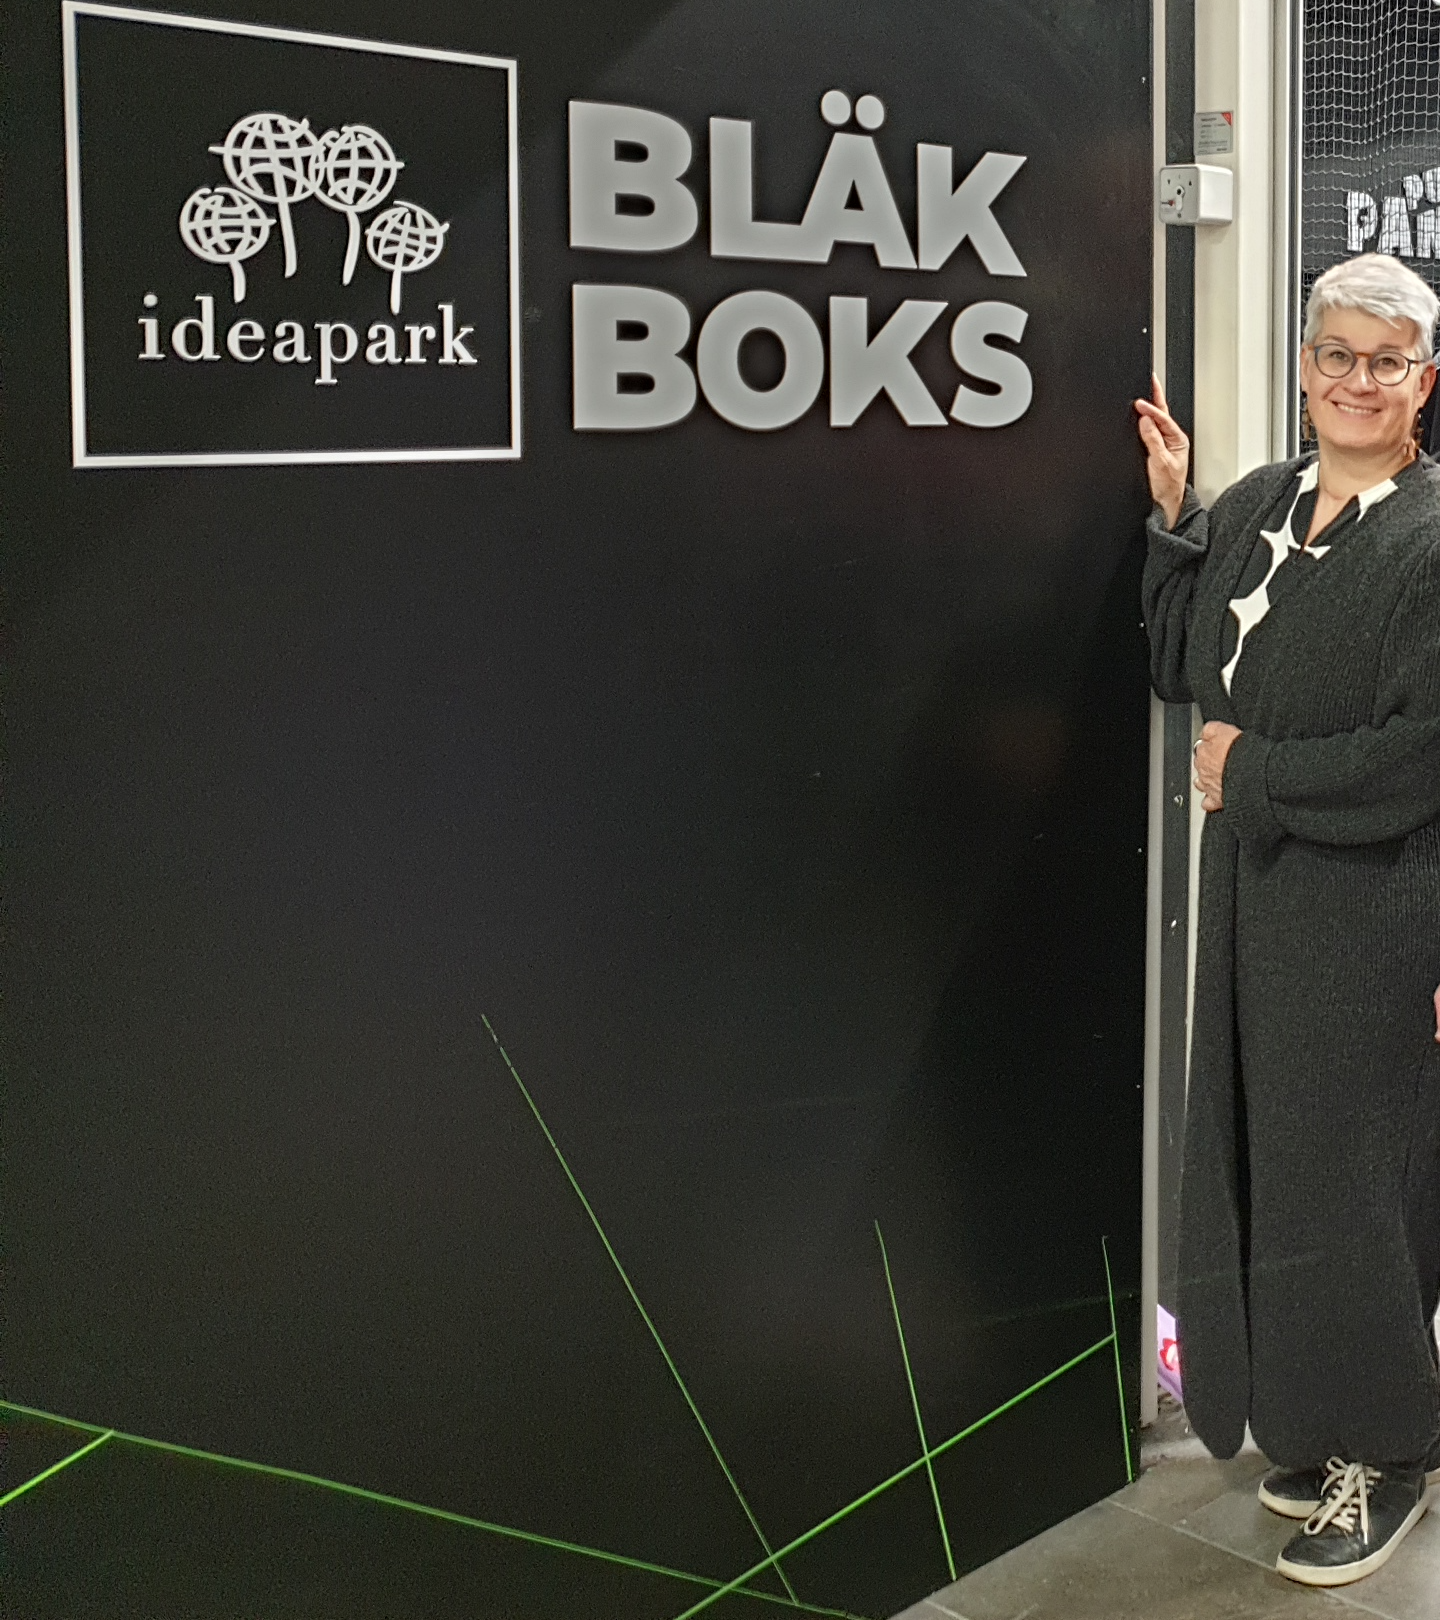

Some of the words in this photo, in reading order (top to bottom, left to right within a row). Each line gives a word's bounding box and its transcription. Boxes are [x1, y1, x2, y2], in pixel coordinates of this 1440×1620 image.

[568, 89, 1028, 278] BLÄK
[137, 293, 478, 385] ideapark
[572, 283, 1034, 431] BOKS
